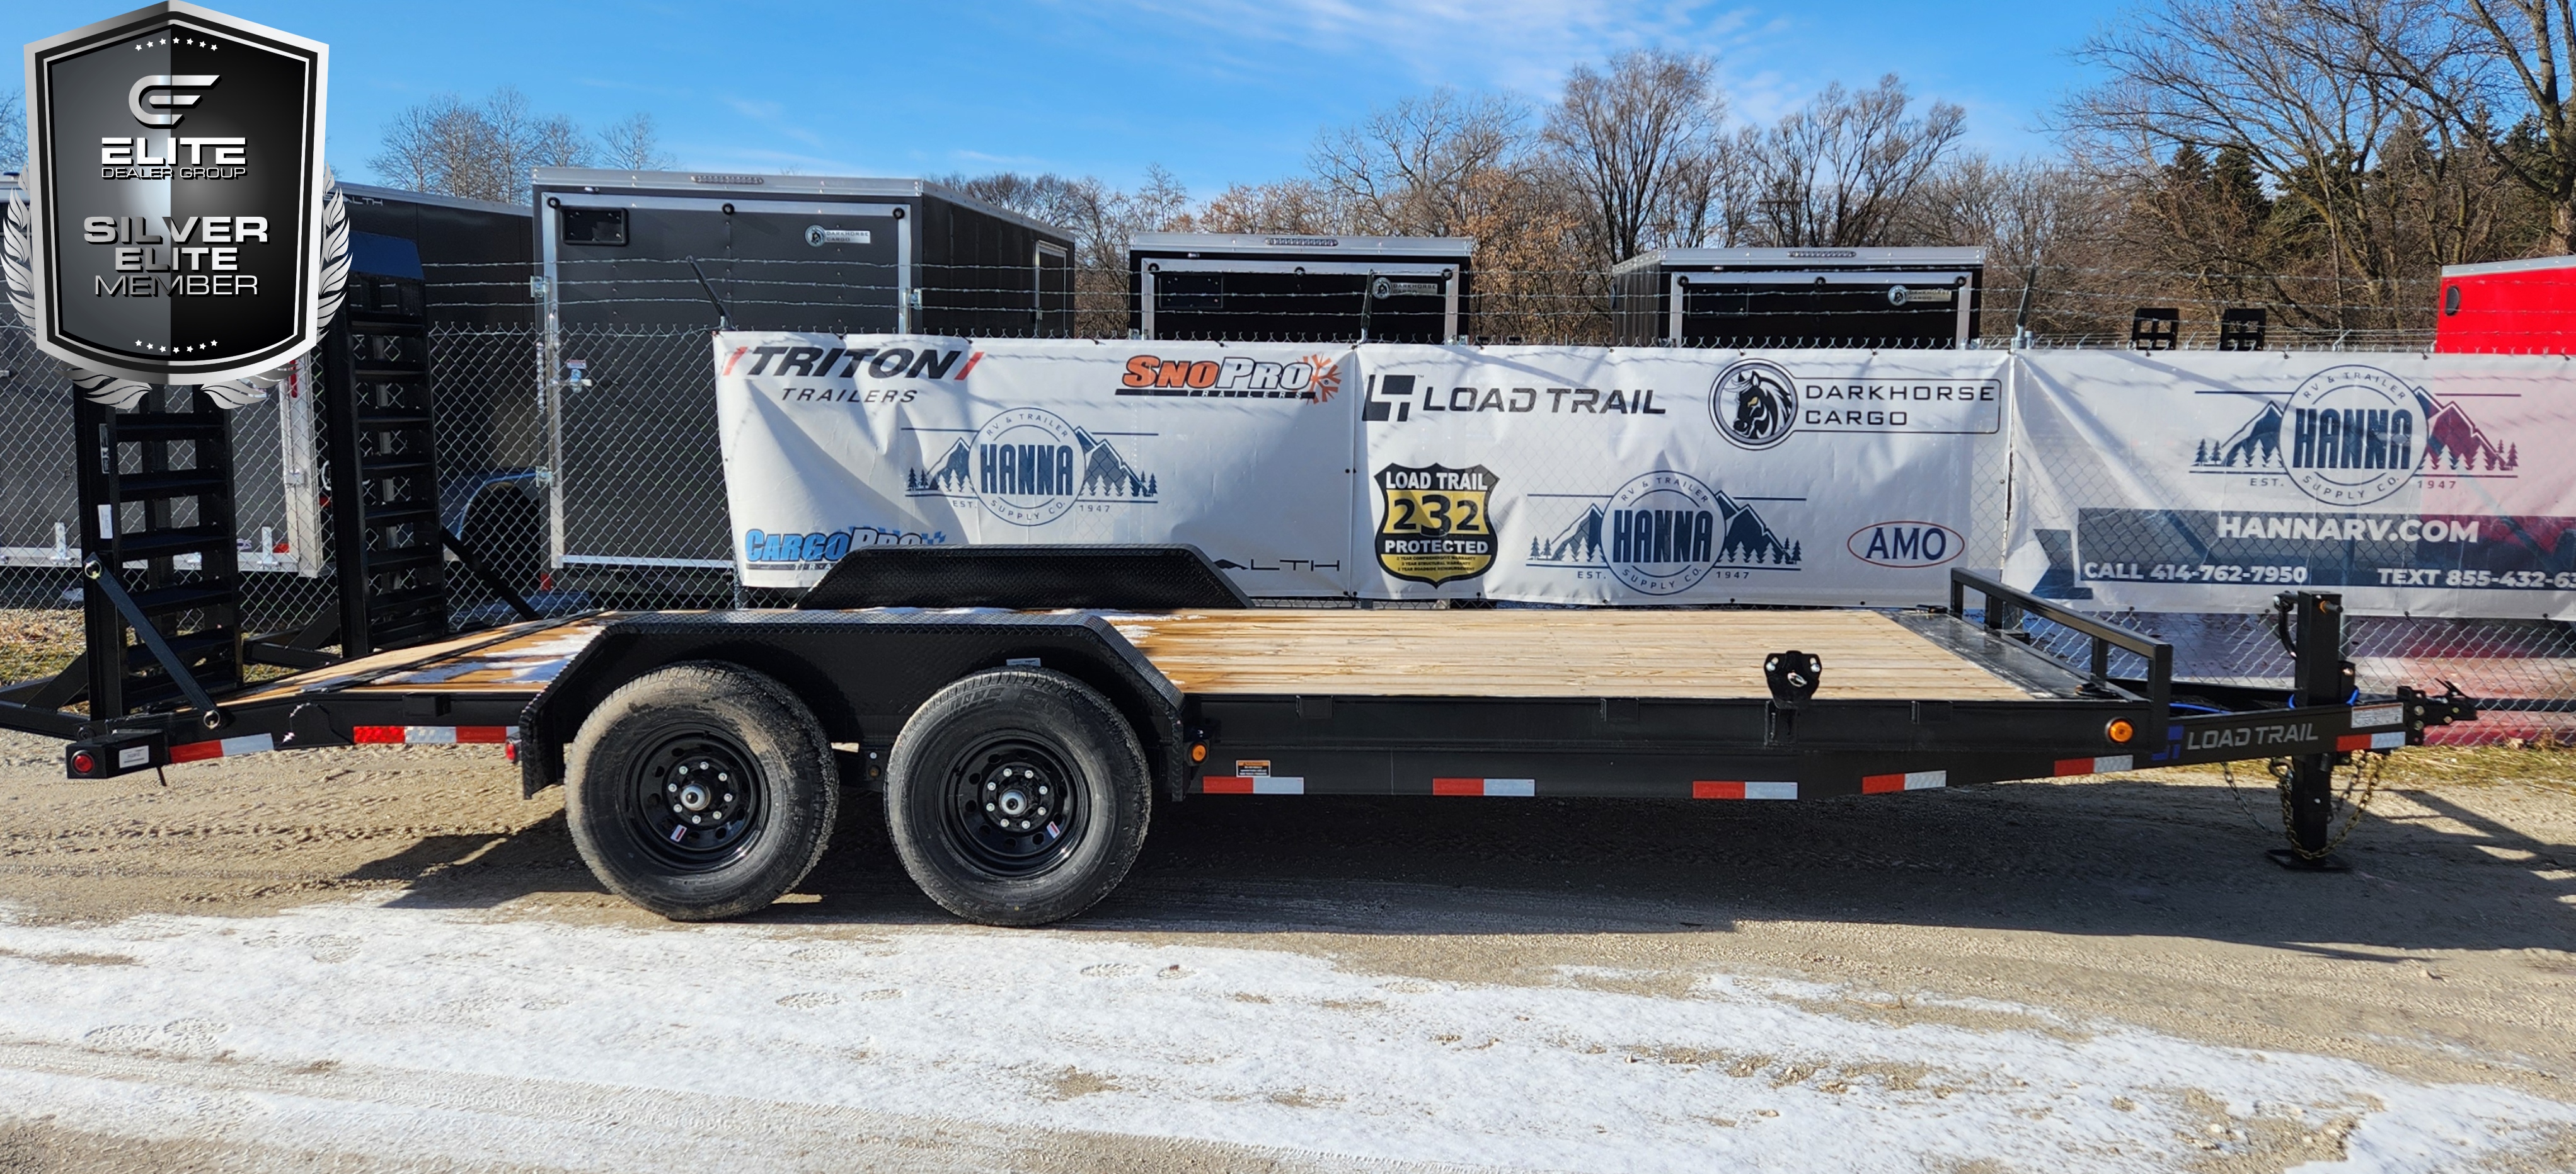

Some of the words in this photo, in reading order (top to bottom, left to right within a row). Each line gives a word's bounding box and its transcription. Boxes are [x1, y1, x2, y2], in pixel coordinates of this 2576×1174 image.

[747, 346, 962, 379] TRITON
[781, 388, 918, 403] TRAILERS
[1187, 390, 1302, 399] TRAILERS
[1806, 385, 1995, 401] DARKHORSE
[2303, 384, 2320, 398] RV
[2343, 372, 2406, 400] TRAILER
[1423, 387, 1537, 413] LOAD
[1546, 388, 1667, 415] TRAIL
[986, 423, 999, 436] RV
[1019, 414, 1069, 437] TRAILER
[1806, 410, 1908, 426] CARGO
[2292, 408, 2413, 469] HANNA
[980, 444, 1073, 496] HANNA
[1386, 471, 1431, 488] LOAD
[1436, 473, 1488, 490] TRAIL
[1621, 488, 1635, 501] RV
[1656, 477, 1708, 502] TRAILER
[2250, 478, 2284, 486] EST.
[2417, 480, 2456, 488] 1947
[2303, 475, 2365, 499] SUPPLY
[953, 500, 977, 509] EST.
[991, 500, 1040, 521] SUPPLY
[1393, 494, 1480, 536] 232
[1613, 510, 1713, 563] HANNA
[2218, 516, 2479, 543] HANNARV.COM
[1385, 540, 1488, 553] PROTECTED
[1865, 527, 1946, 560] AMO
[1577, 571, 1606, 579] EST.
[1622, 569, 1675, 589] SUPPLY
[2084, 562, 2144, 579] CALL
[2150, 564, 2308, 584] 414-762-7950
[2377, 568, 2441, 585] TEXT
[2187, 728, 2250, 751] LOAD
[2255, 723, 2318, 744] TRAIL
